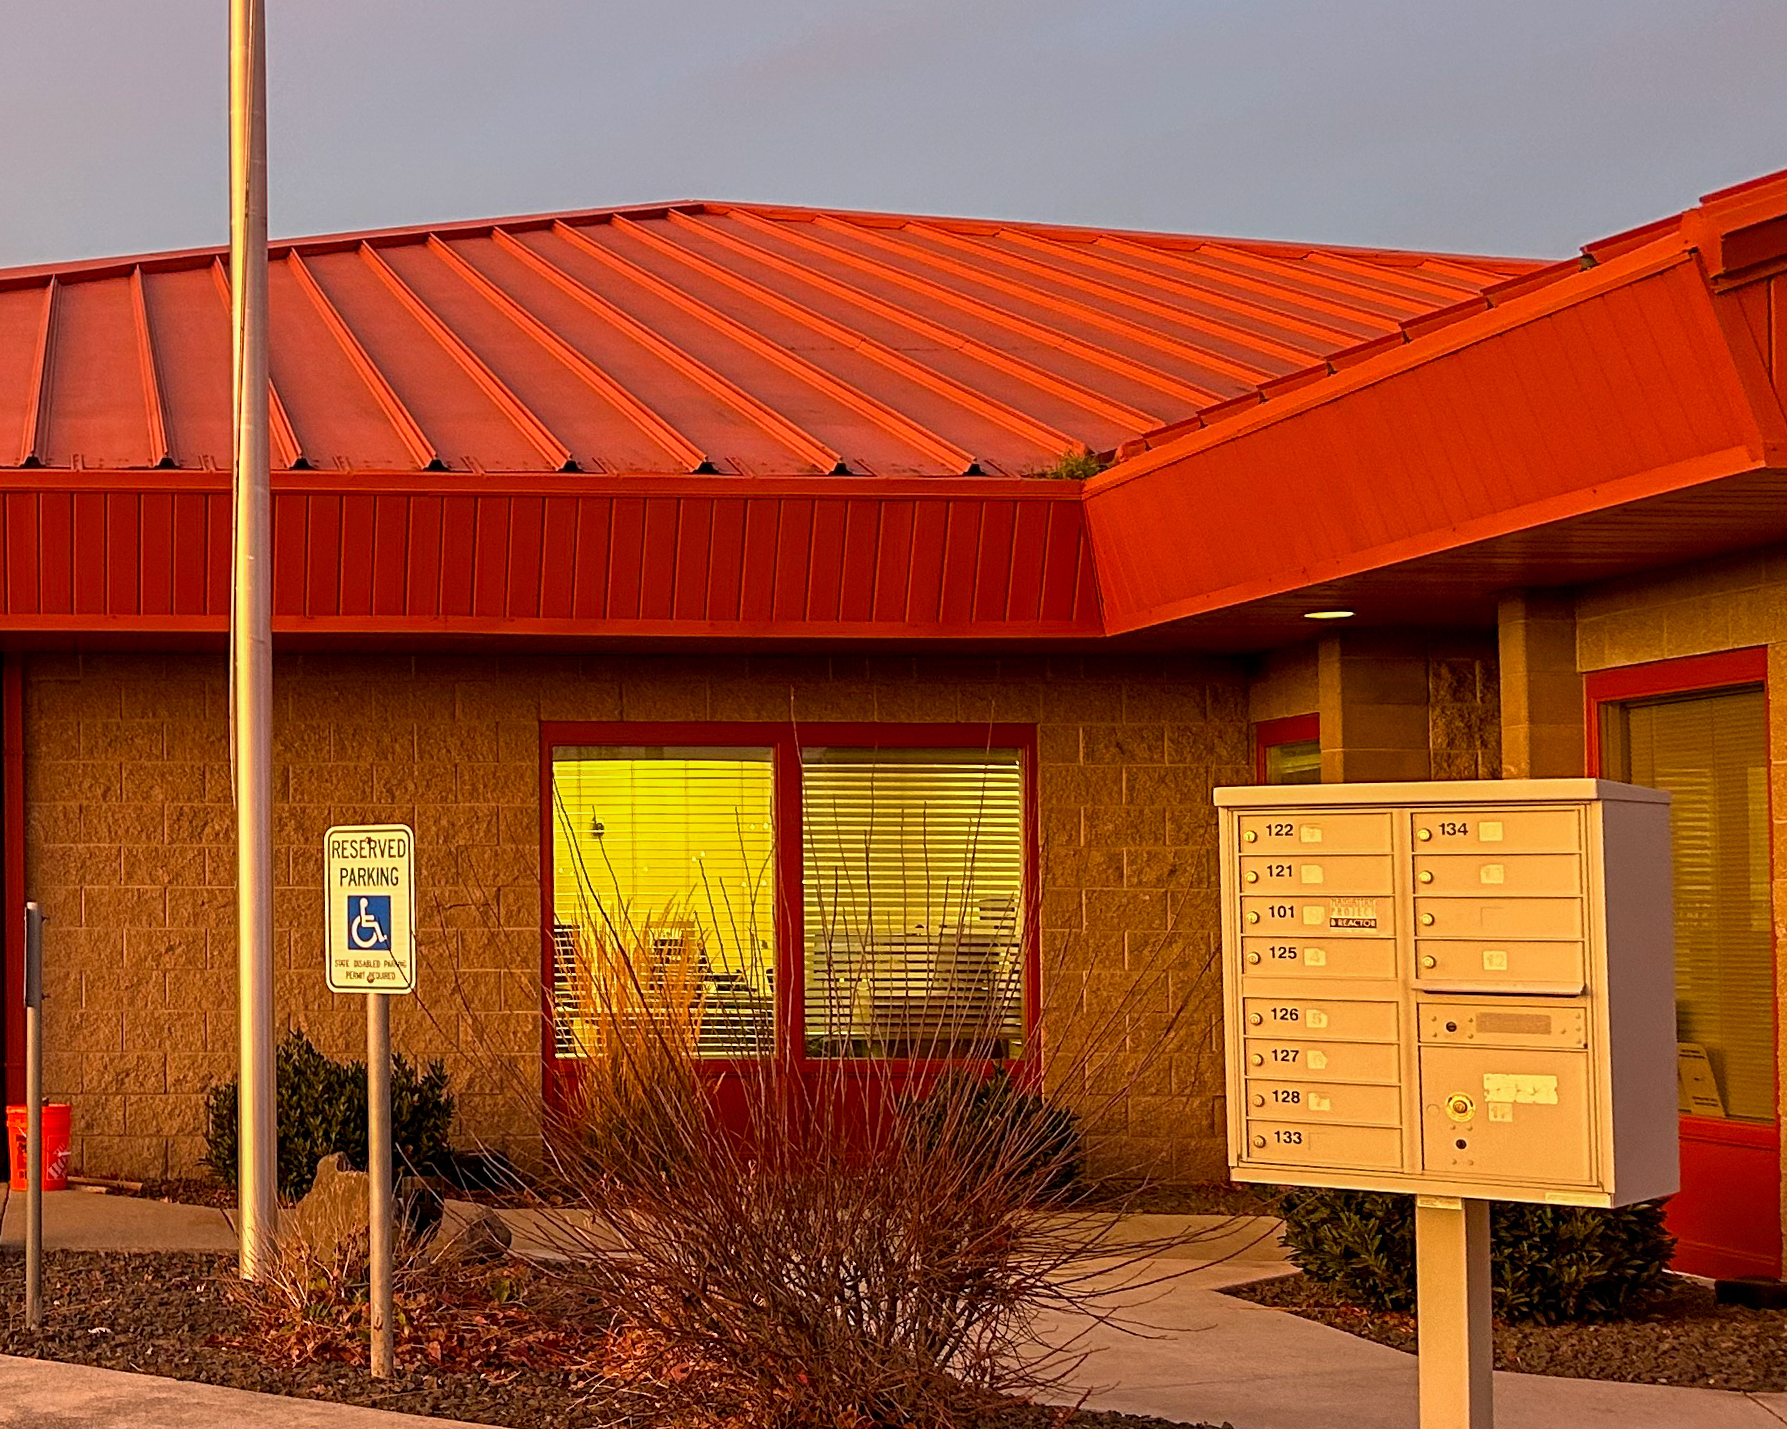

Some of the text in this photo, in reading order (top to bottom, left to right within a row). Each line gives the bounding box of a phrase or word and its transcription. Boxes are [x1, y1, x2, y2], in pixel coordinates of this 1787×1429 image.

[1265, 823, 1294, 837] 122
[1438, 822, 1469, 836] 134
[331, 838, 407, 859] RESERVED
[339, 867, 400, 887] PARKING
[1266, 865, 1293, 878] 121
[1268, 905, 1295, 919] 101
[1337, 919, 1376, 927] REACTOR
[1269, 946, 1297, 960] 125
[353, 959, 381, 969] DISABLED
[1270, 1008, 1299, 1022] 126
[1271, 1049, 1300, 1063] 127
[1272, 1090, 1301, 1104] 128
[1273, 1131, 1303, 1145] 133
